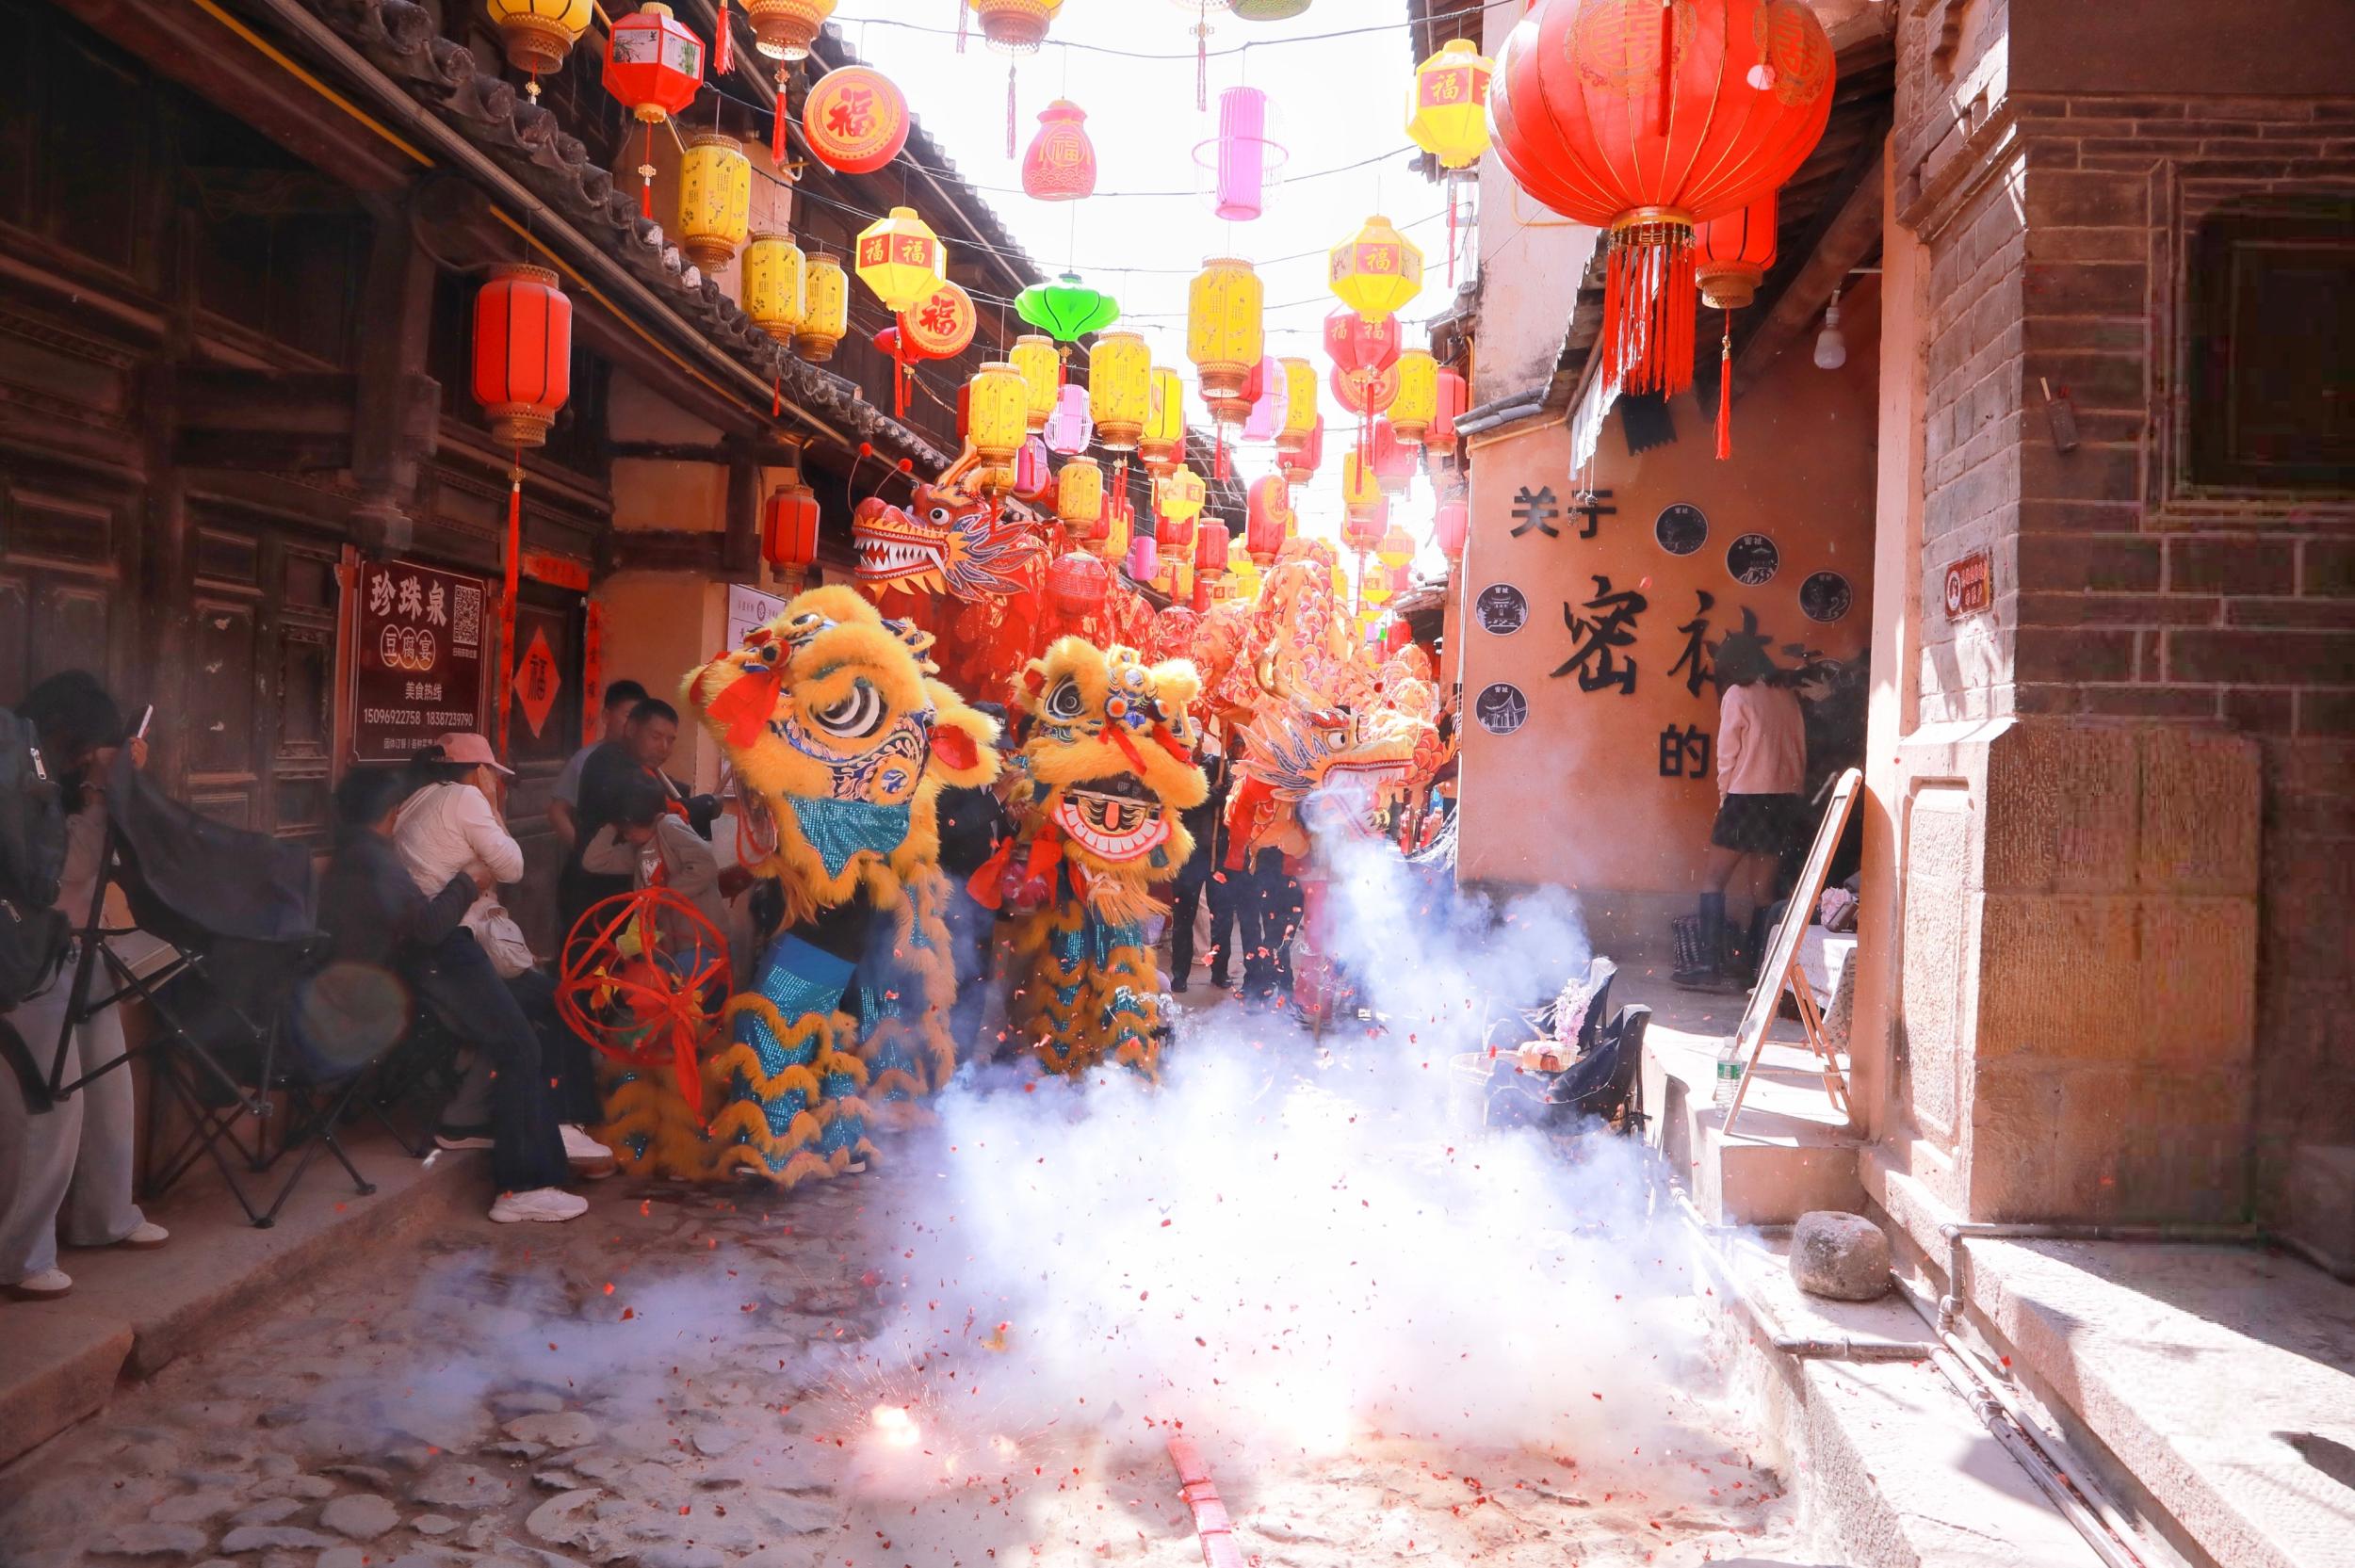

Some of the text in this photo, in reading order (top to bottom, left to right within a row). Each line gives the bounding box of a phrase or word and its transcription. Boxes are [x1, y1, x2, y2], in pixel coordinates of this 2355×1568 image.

[1431, 73, 1459, 101] 福
[827, 88, 877, 137] 福
[1051, 135, 1080, 161] 福
[866, 240, 885, 262] 福
[902, 240, 925, 265] 福
[1366, 248, 1391, 271] 福
[919, 295, 957, 335] 福
[1331, 320, 1347, 340] 福
[1365, 320, 1387, 340] 福
[1511, 486, 1616, 539] 关于
[369, 571, 447, 627] 珍珠泉
[383, 632, 433, 663] 豆腐宴
[405, 681, 443, 702] 美食热线
[528, 654, 547, 702] 福
[364, 708, 473, 727] 15096922758 18387239790
[1660, 723, 1710, 779] 的
